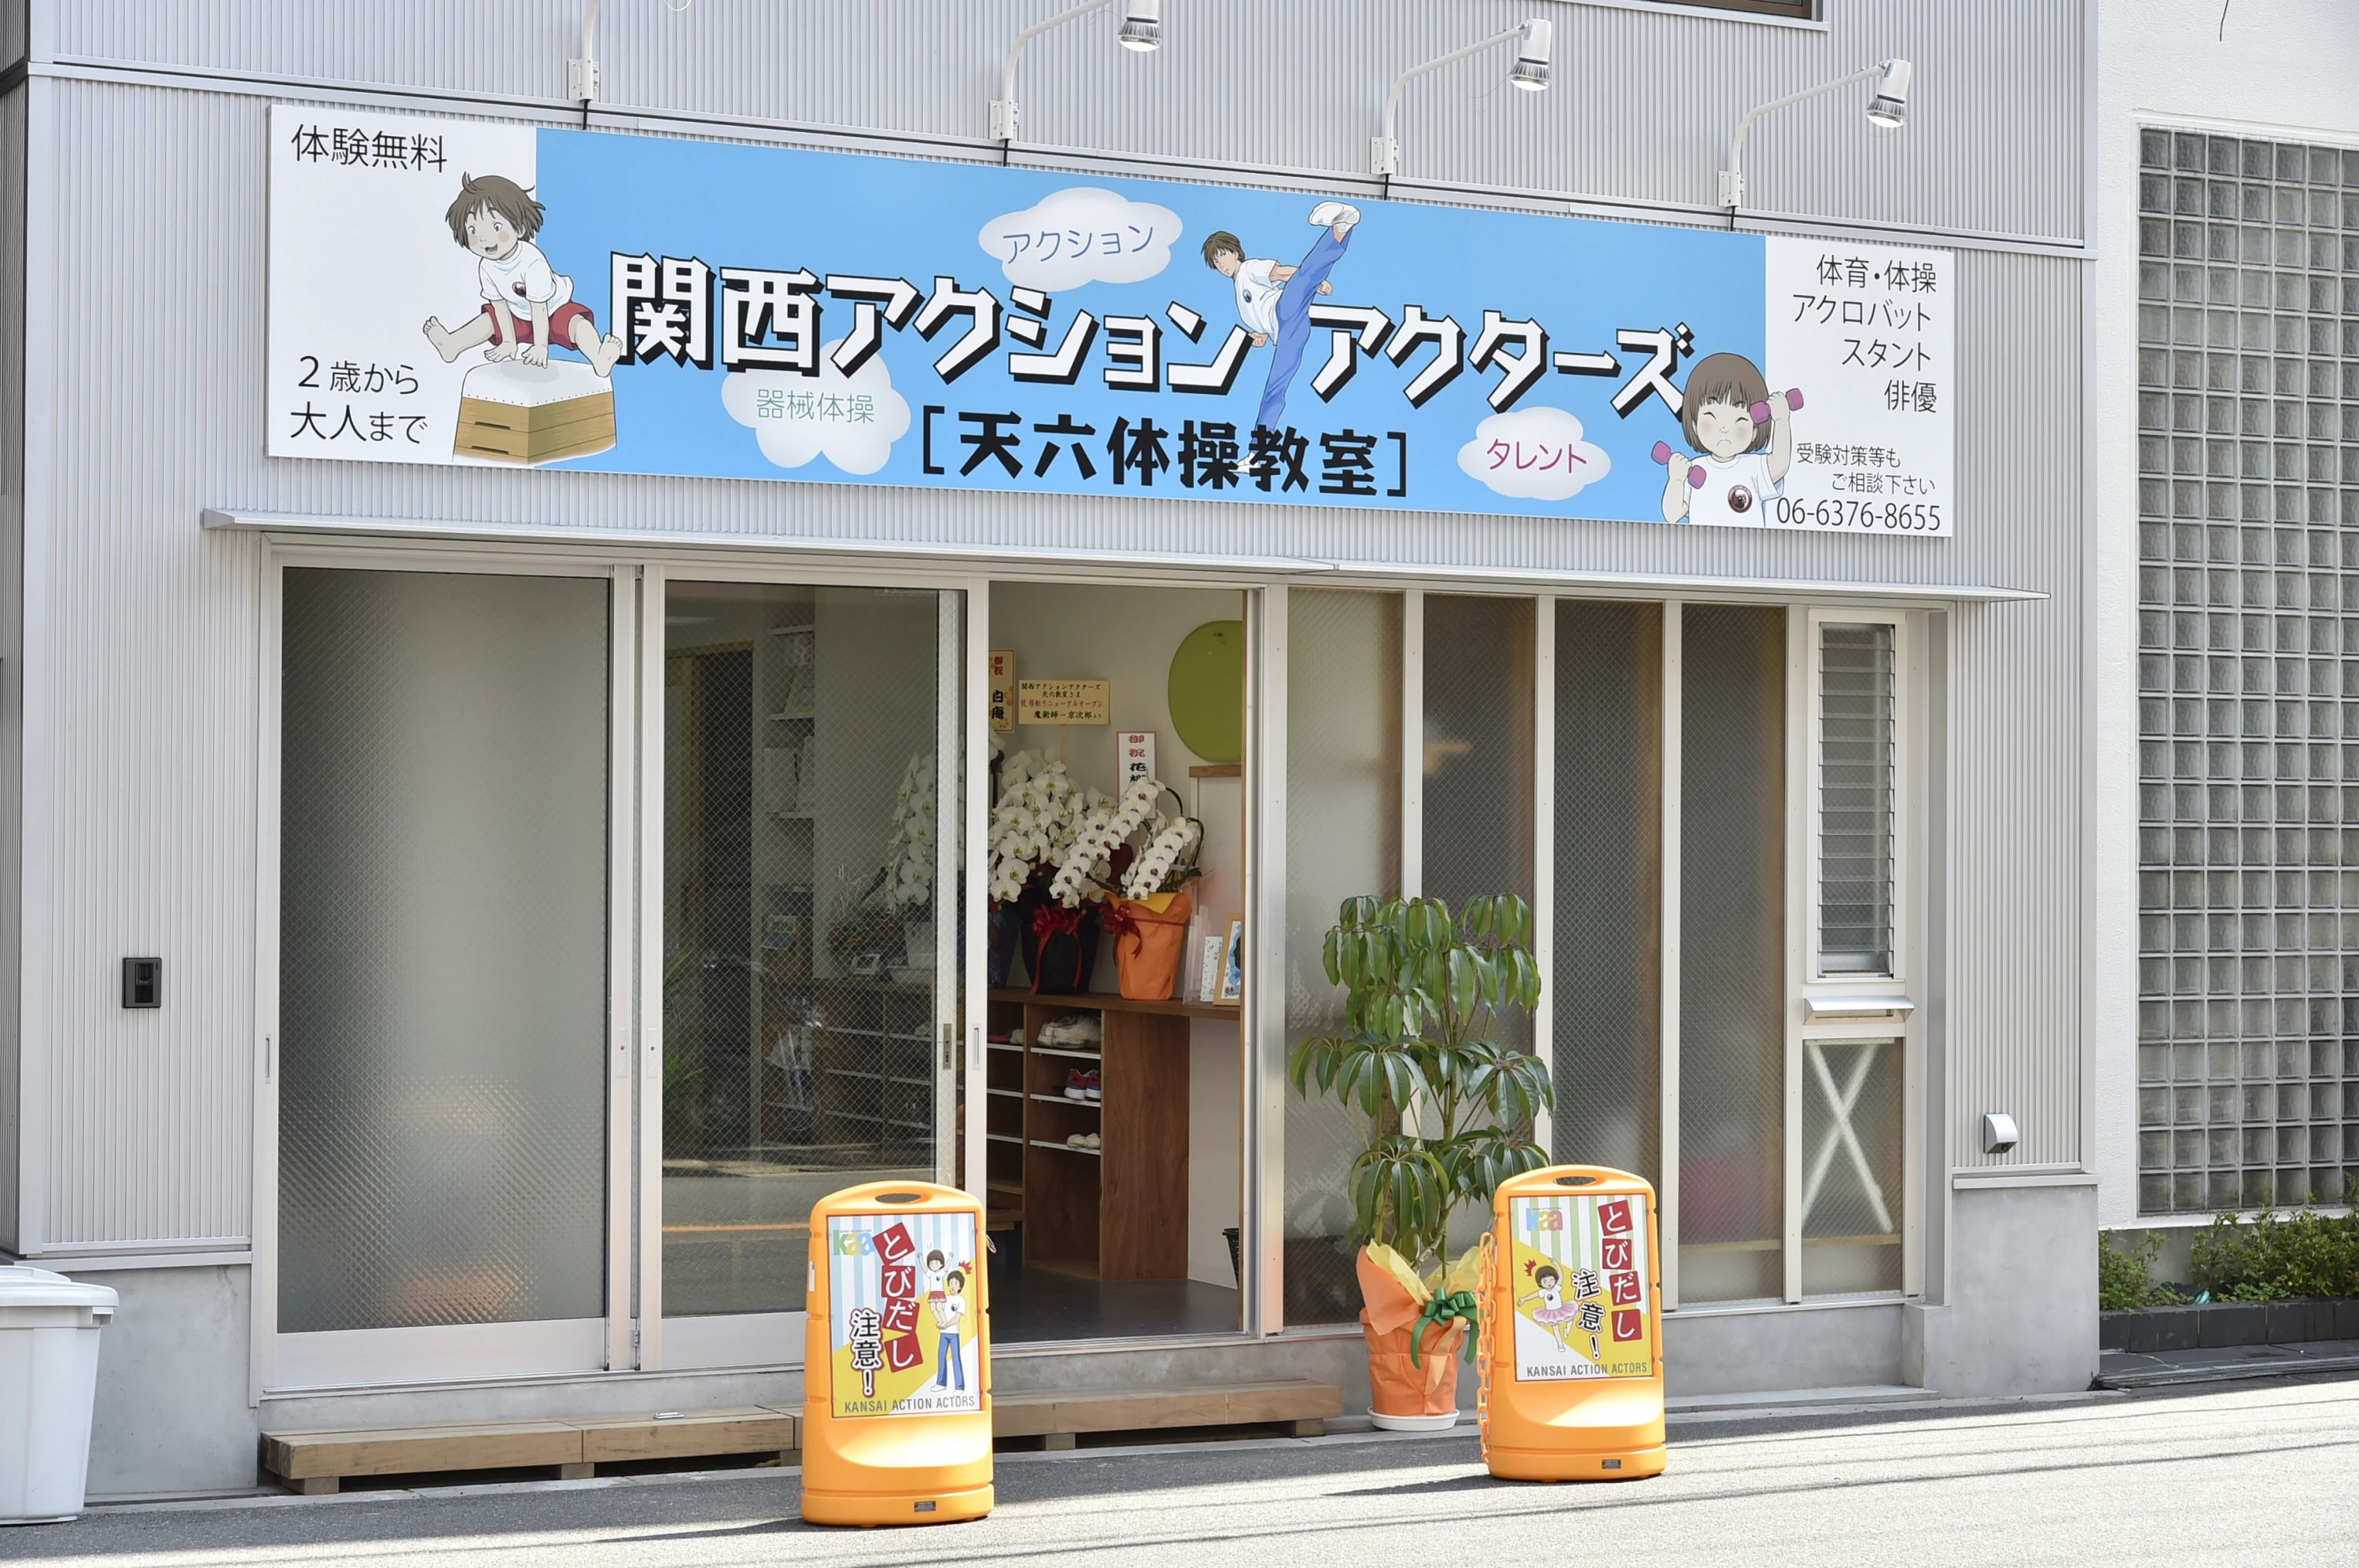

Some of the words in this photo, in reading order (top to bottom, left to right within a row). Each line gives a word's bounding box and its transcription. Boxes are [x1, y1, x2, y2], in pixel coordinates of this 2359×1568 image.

[290, 123, 447, 173] 体験無料
[1002, 225, 1153, 263] アクション
[1816, 253, 1937, 293] 体育・体操
[1792, 293, 1931, 331] アクロバット
[610, 251, 1253, 396] 関西アクション
[1308, 304, 1695, 418] アクターズ
[1842, 338, 1931, 371] スタント
[297, 355, 420, 395] 2歳から
[756, 388, 874, 424] 器械体操
[1883, 379, 1937, 414] 俳優
[289, 400, 427, 444] 大人まで
[1486, 438, 1587, 474] タレント
[1796, 443, 1901, 468] 受験対策等も
[1831, 472, 1936, 495] ご相談下さい
[1776, 497, 1941, 531] 06-6376-8655
[1128, 734, 1146, 757] 御祝
[1603, 1205, 1639, 1339] とびだし
[880, 1229, 918, 1367] とびだし
[1573, 1270, 1605, 1359] 注意！
[851, 1309, 881, 1396] 注意！
[1527, 1365, 1566, 1377] KANSAI
[1570, 1364, 1608, 1375] ACTION
[1612, 1362, 1647, 1374] ACTORS
[845, 1401, 888, 1413] KANSAI
[892, 1397, 932, 1411] ACTION
[936, 1395, 975, 1408] ACTORS
